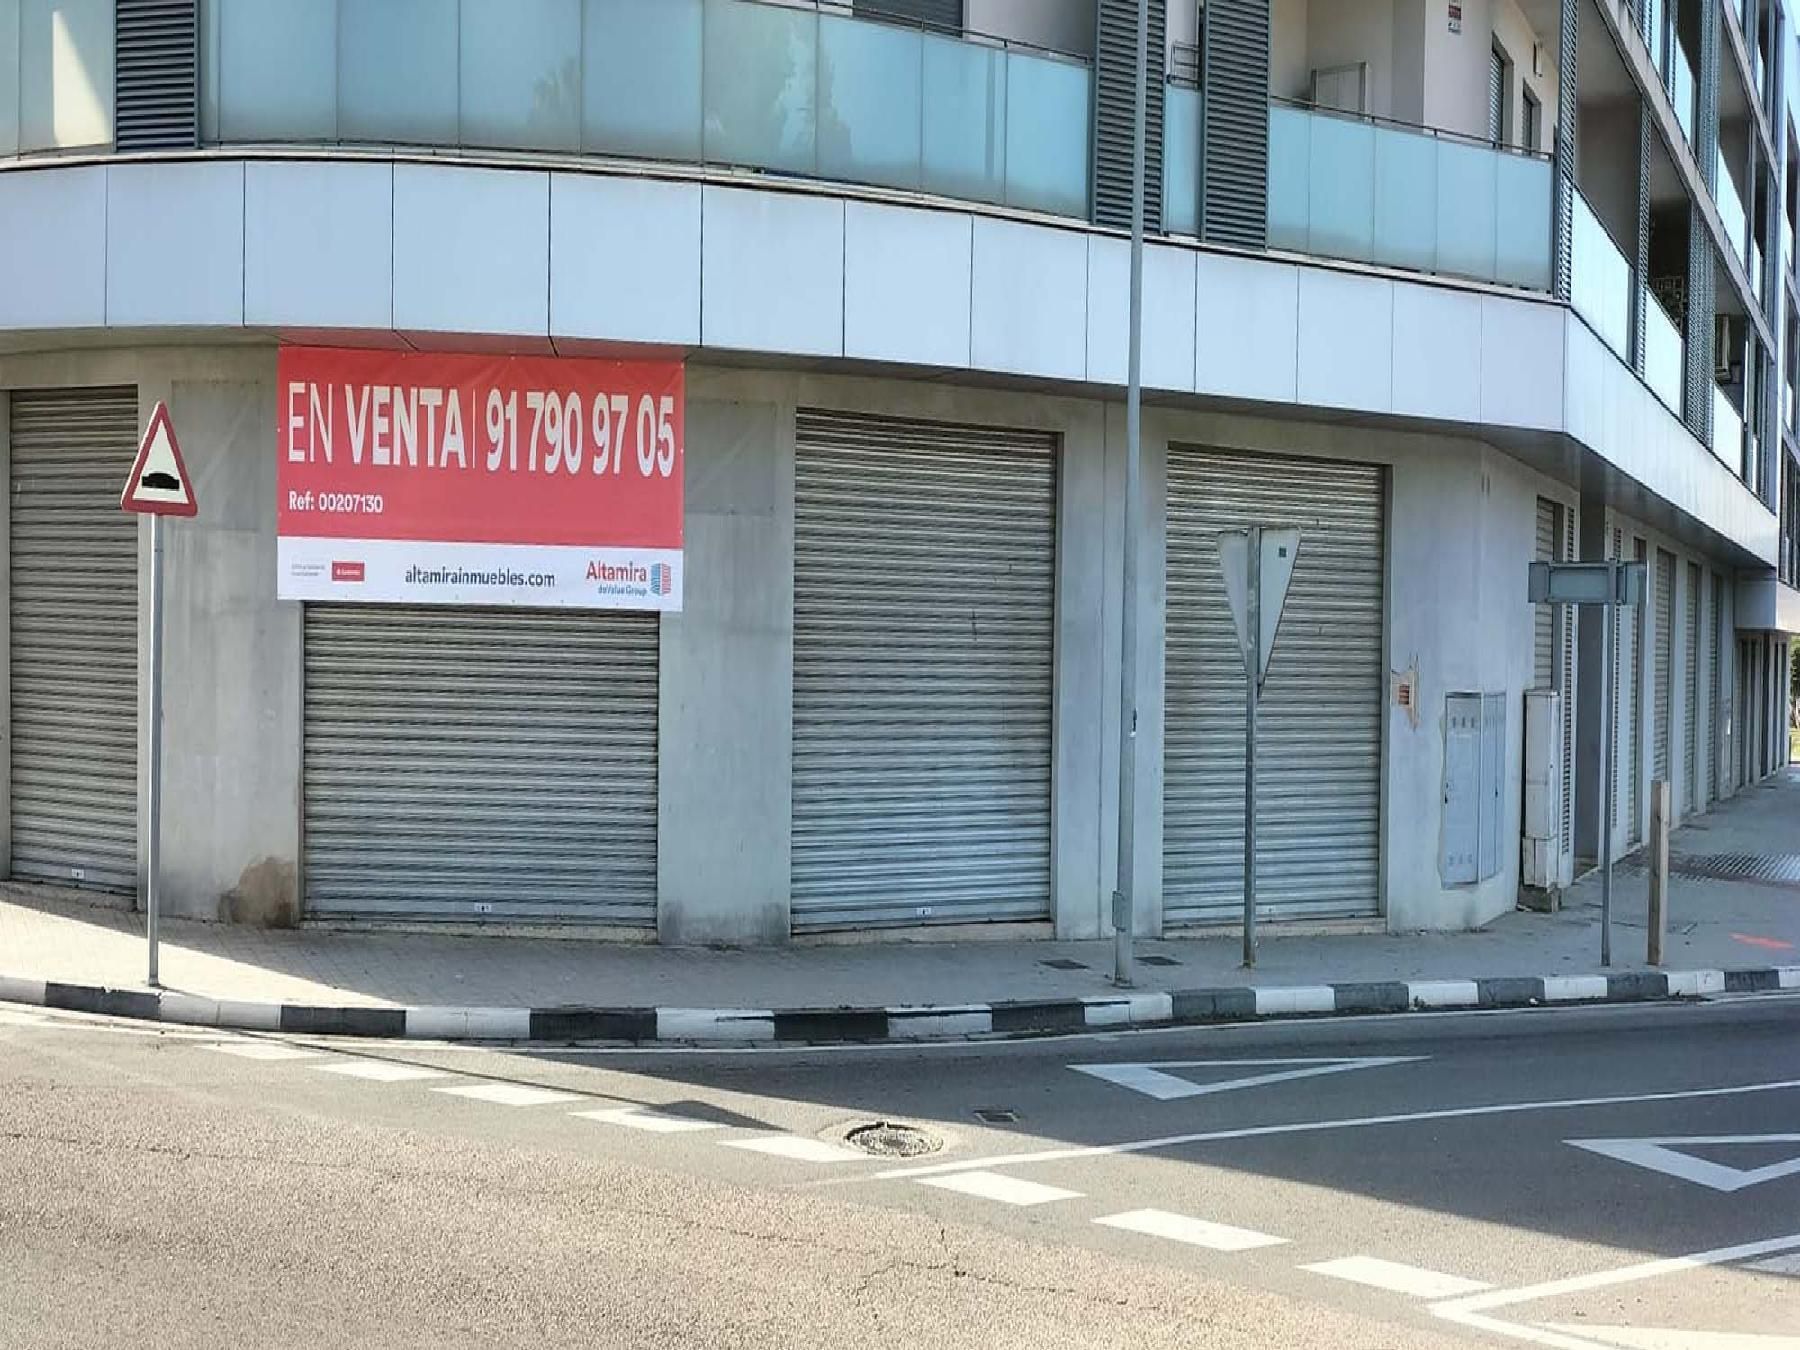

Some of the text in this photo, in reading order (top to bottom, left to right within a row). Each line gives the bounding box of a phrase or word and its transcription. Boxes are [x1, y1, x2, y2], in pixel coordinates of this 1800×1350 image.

[288, 382, 675, 477] EN VENTA 91 790 97 05
[288, 490, 384, 513] Ref: 00207130
[405, 563, 556, 588] altamirainmuebles.com
[586, 560, 647, 582] Altamira
